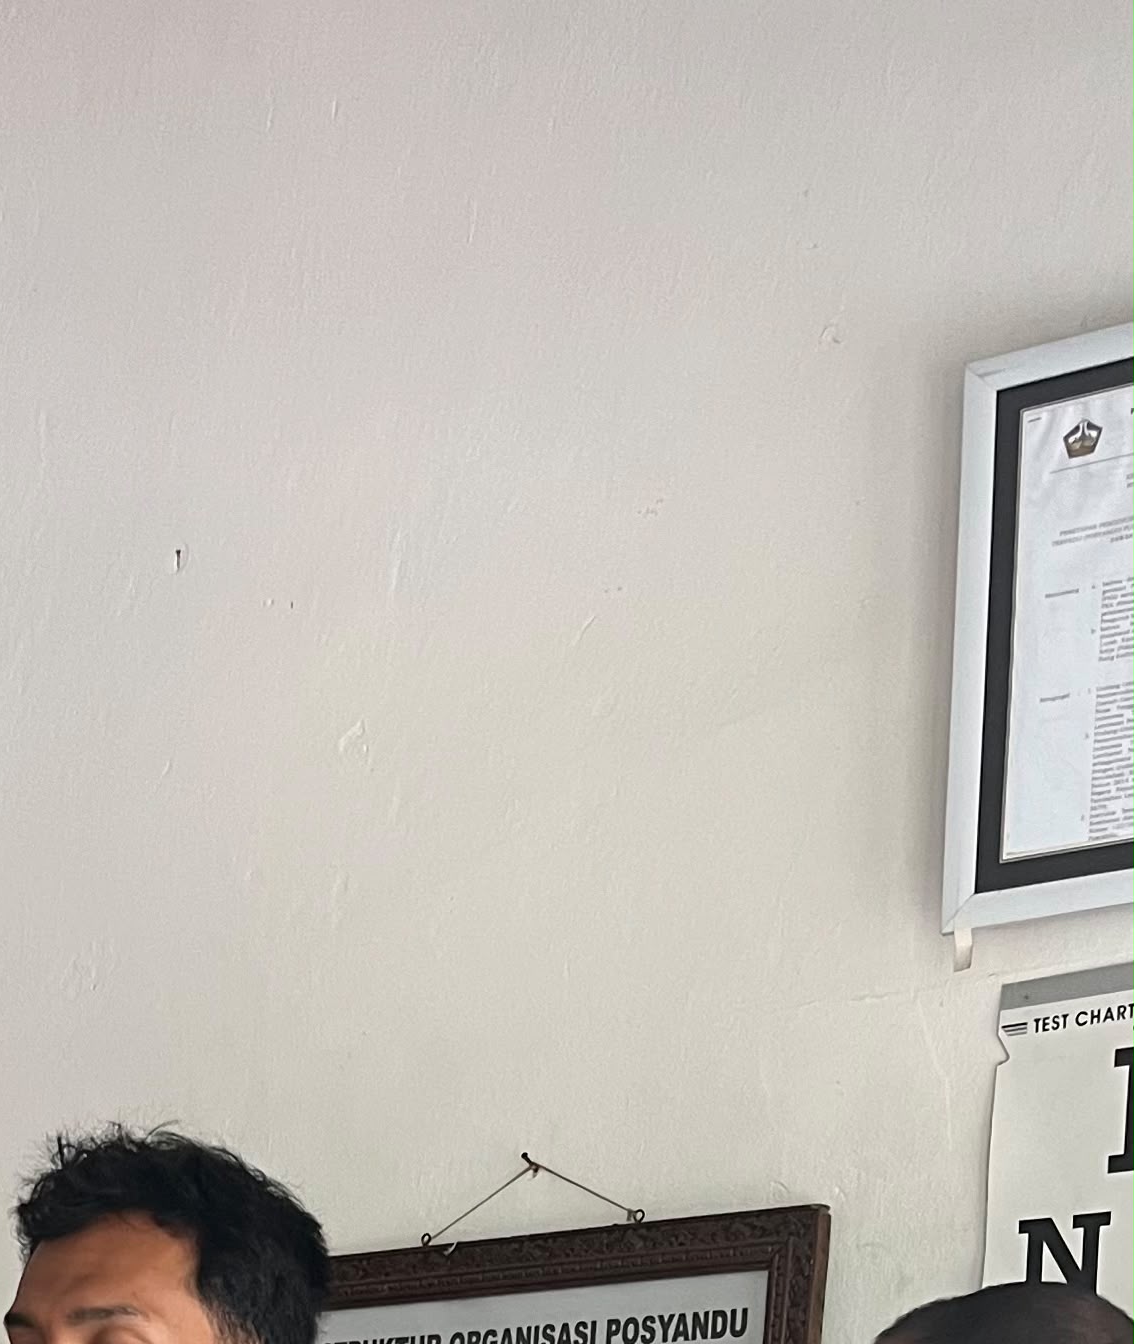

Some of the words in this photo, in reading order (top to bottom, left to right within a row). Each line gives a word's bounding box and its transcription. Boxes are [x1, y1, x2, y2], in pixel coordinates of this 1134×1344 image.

[1033, 1013, 1069, 1034] TEST
[1074, 1003, 1134, 1027] CHART
[1018, 1210, 1112, 1296] N
